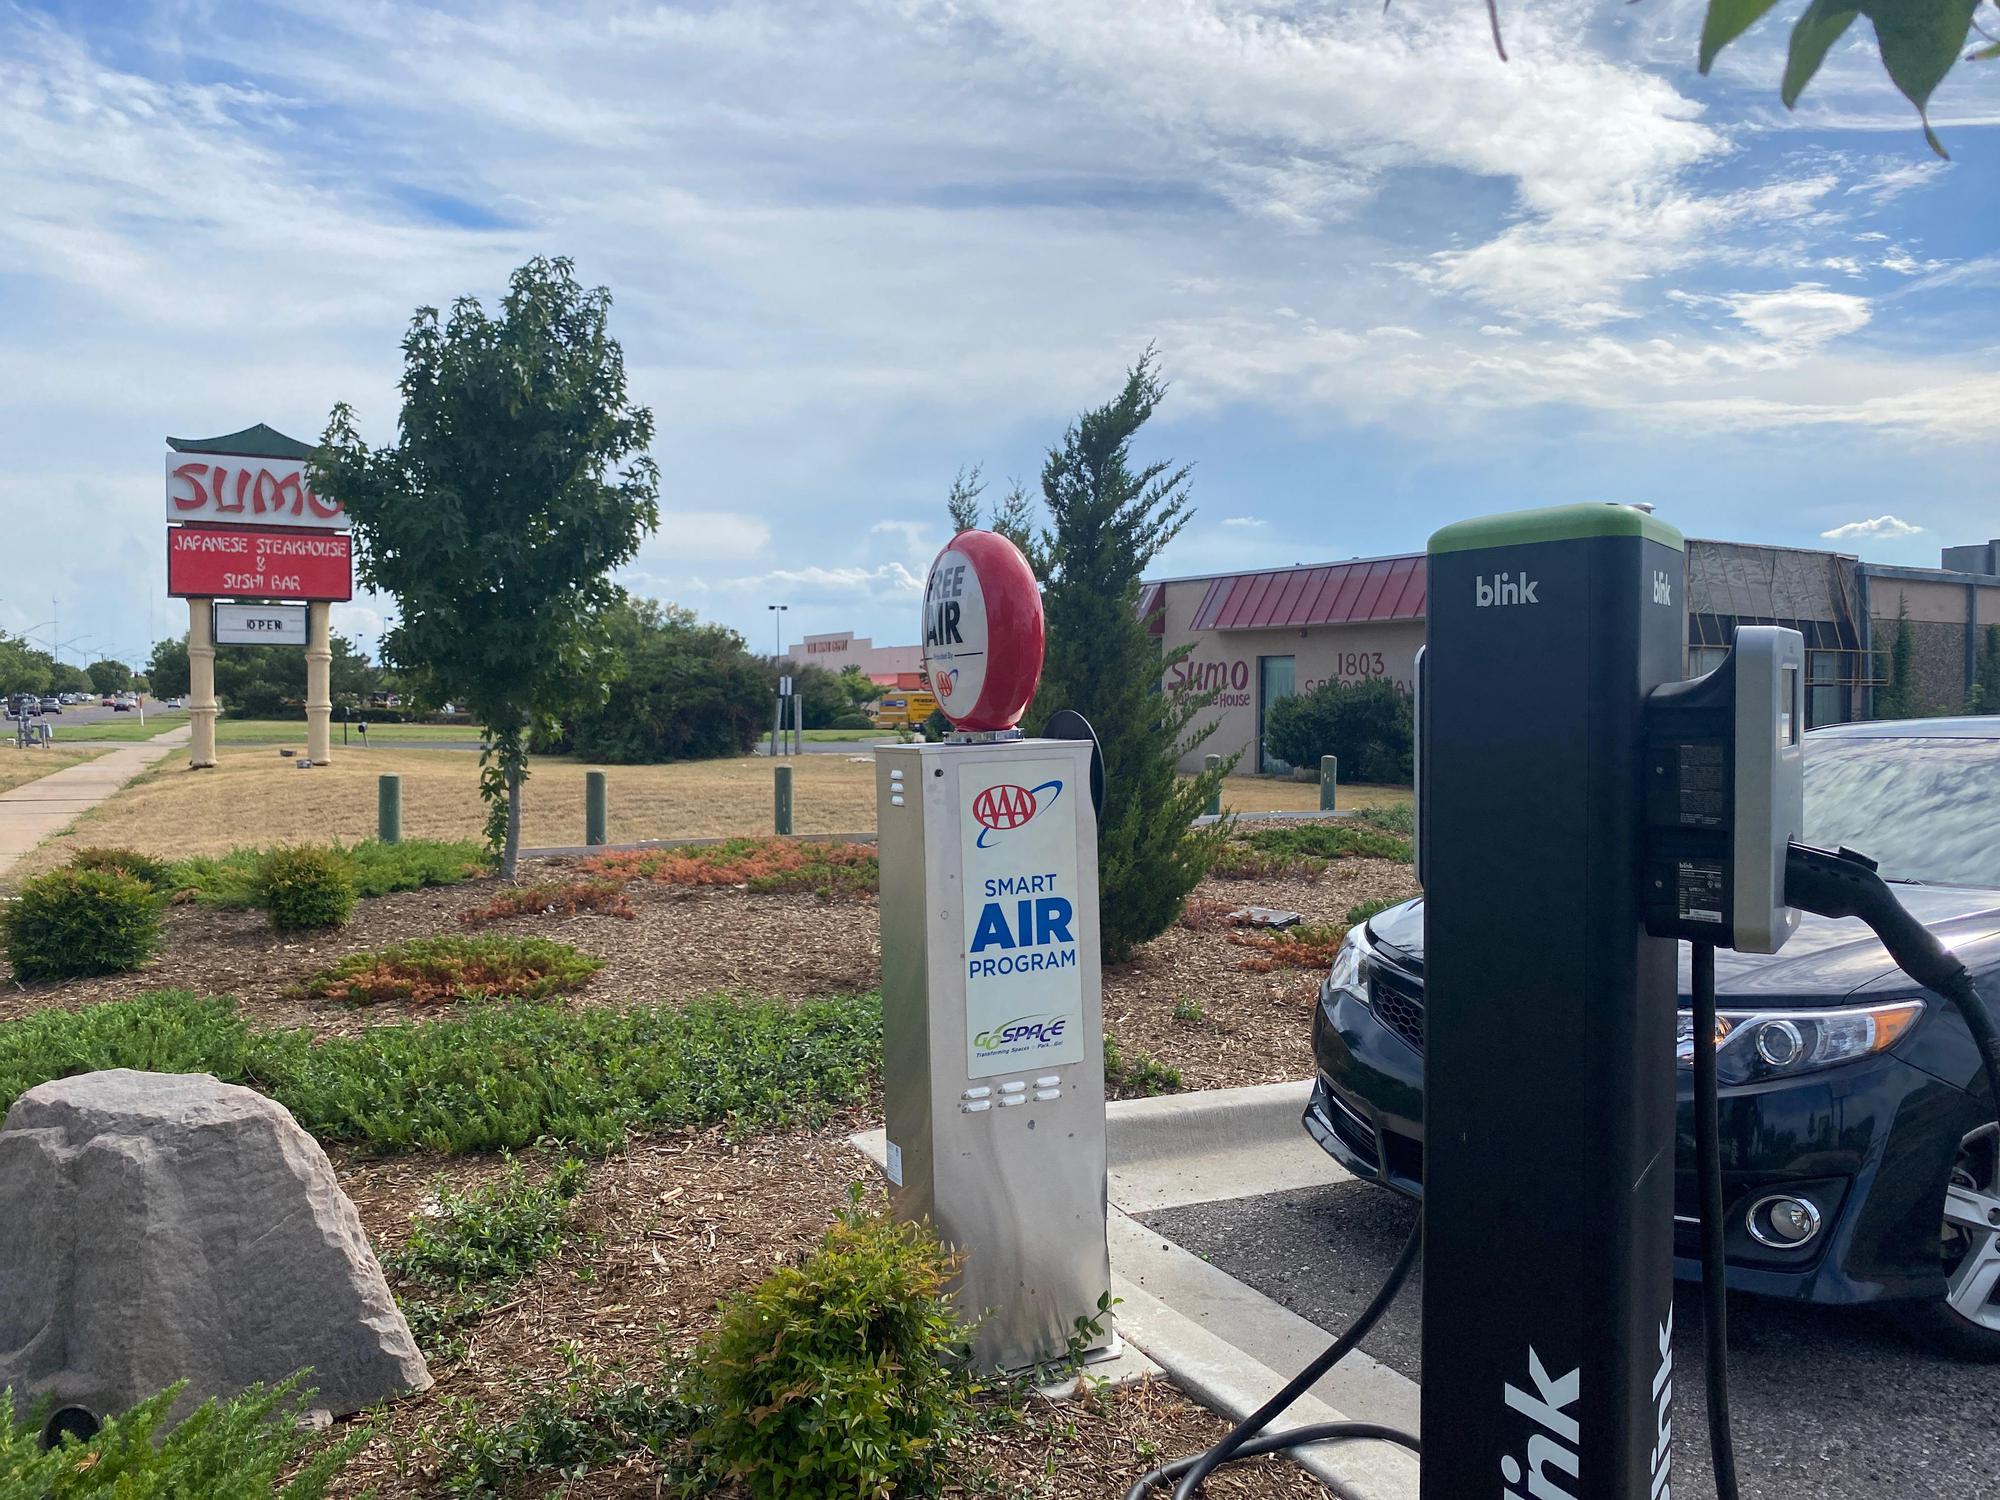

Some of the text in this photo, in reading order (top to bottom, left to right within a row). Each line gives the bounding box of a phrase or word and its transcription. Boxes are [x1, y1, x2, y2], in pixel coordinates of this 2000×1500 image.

[174, 535, 347, 558] JAPANESE STEAKHOUSE
[256, 556, 266, 572] &
[223, 573, 301, 591] SUSHI BAR
[927, 565, 966, 602] FREE
[1476, 572, 1539, 607] blink
[1653, 571, 1671, 606] blink
[249, 620, 282, 630] OPEN
[926, 601, 963, 648] AIR
[1338, 653, 1384, 675] 1803
[973, 785, 1036, 830] AAA
[985, 874, 1057, 897] SMART
[970, 897, 1074, 953] AIR
[970, 950, 1076, 978] PROGRAM
